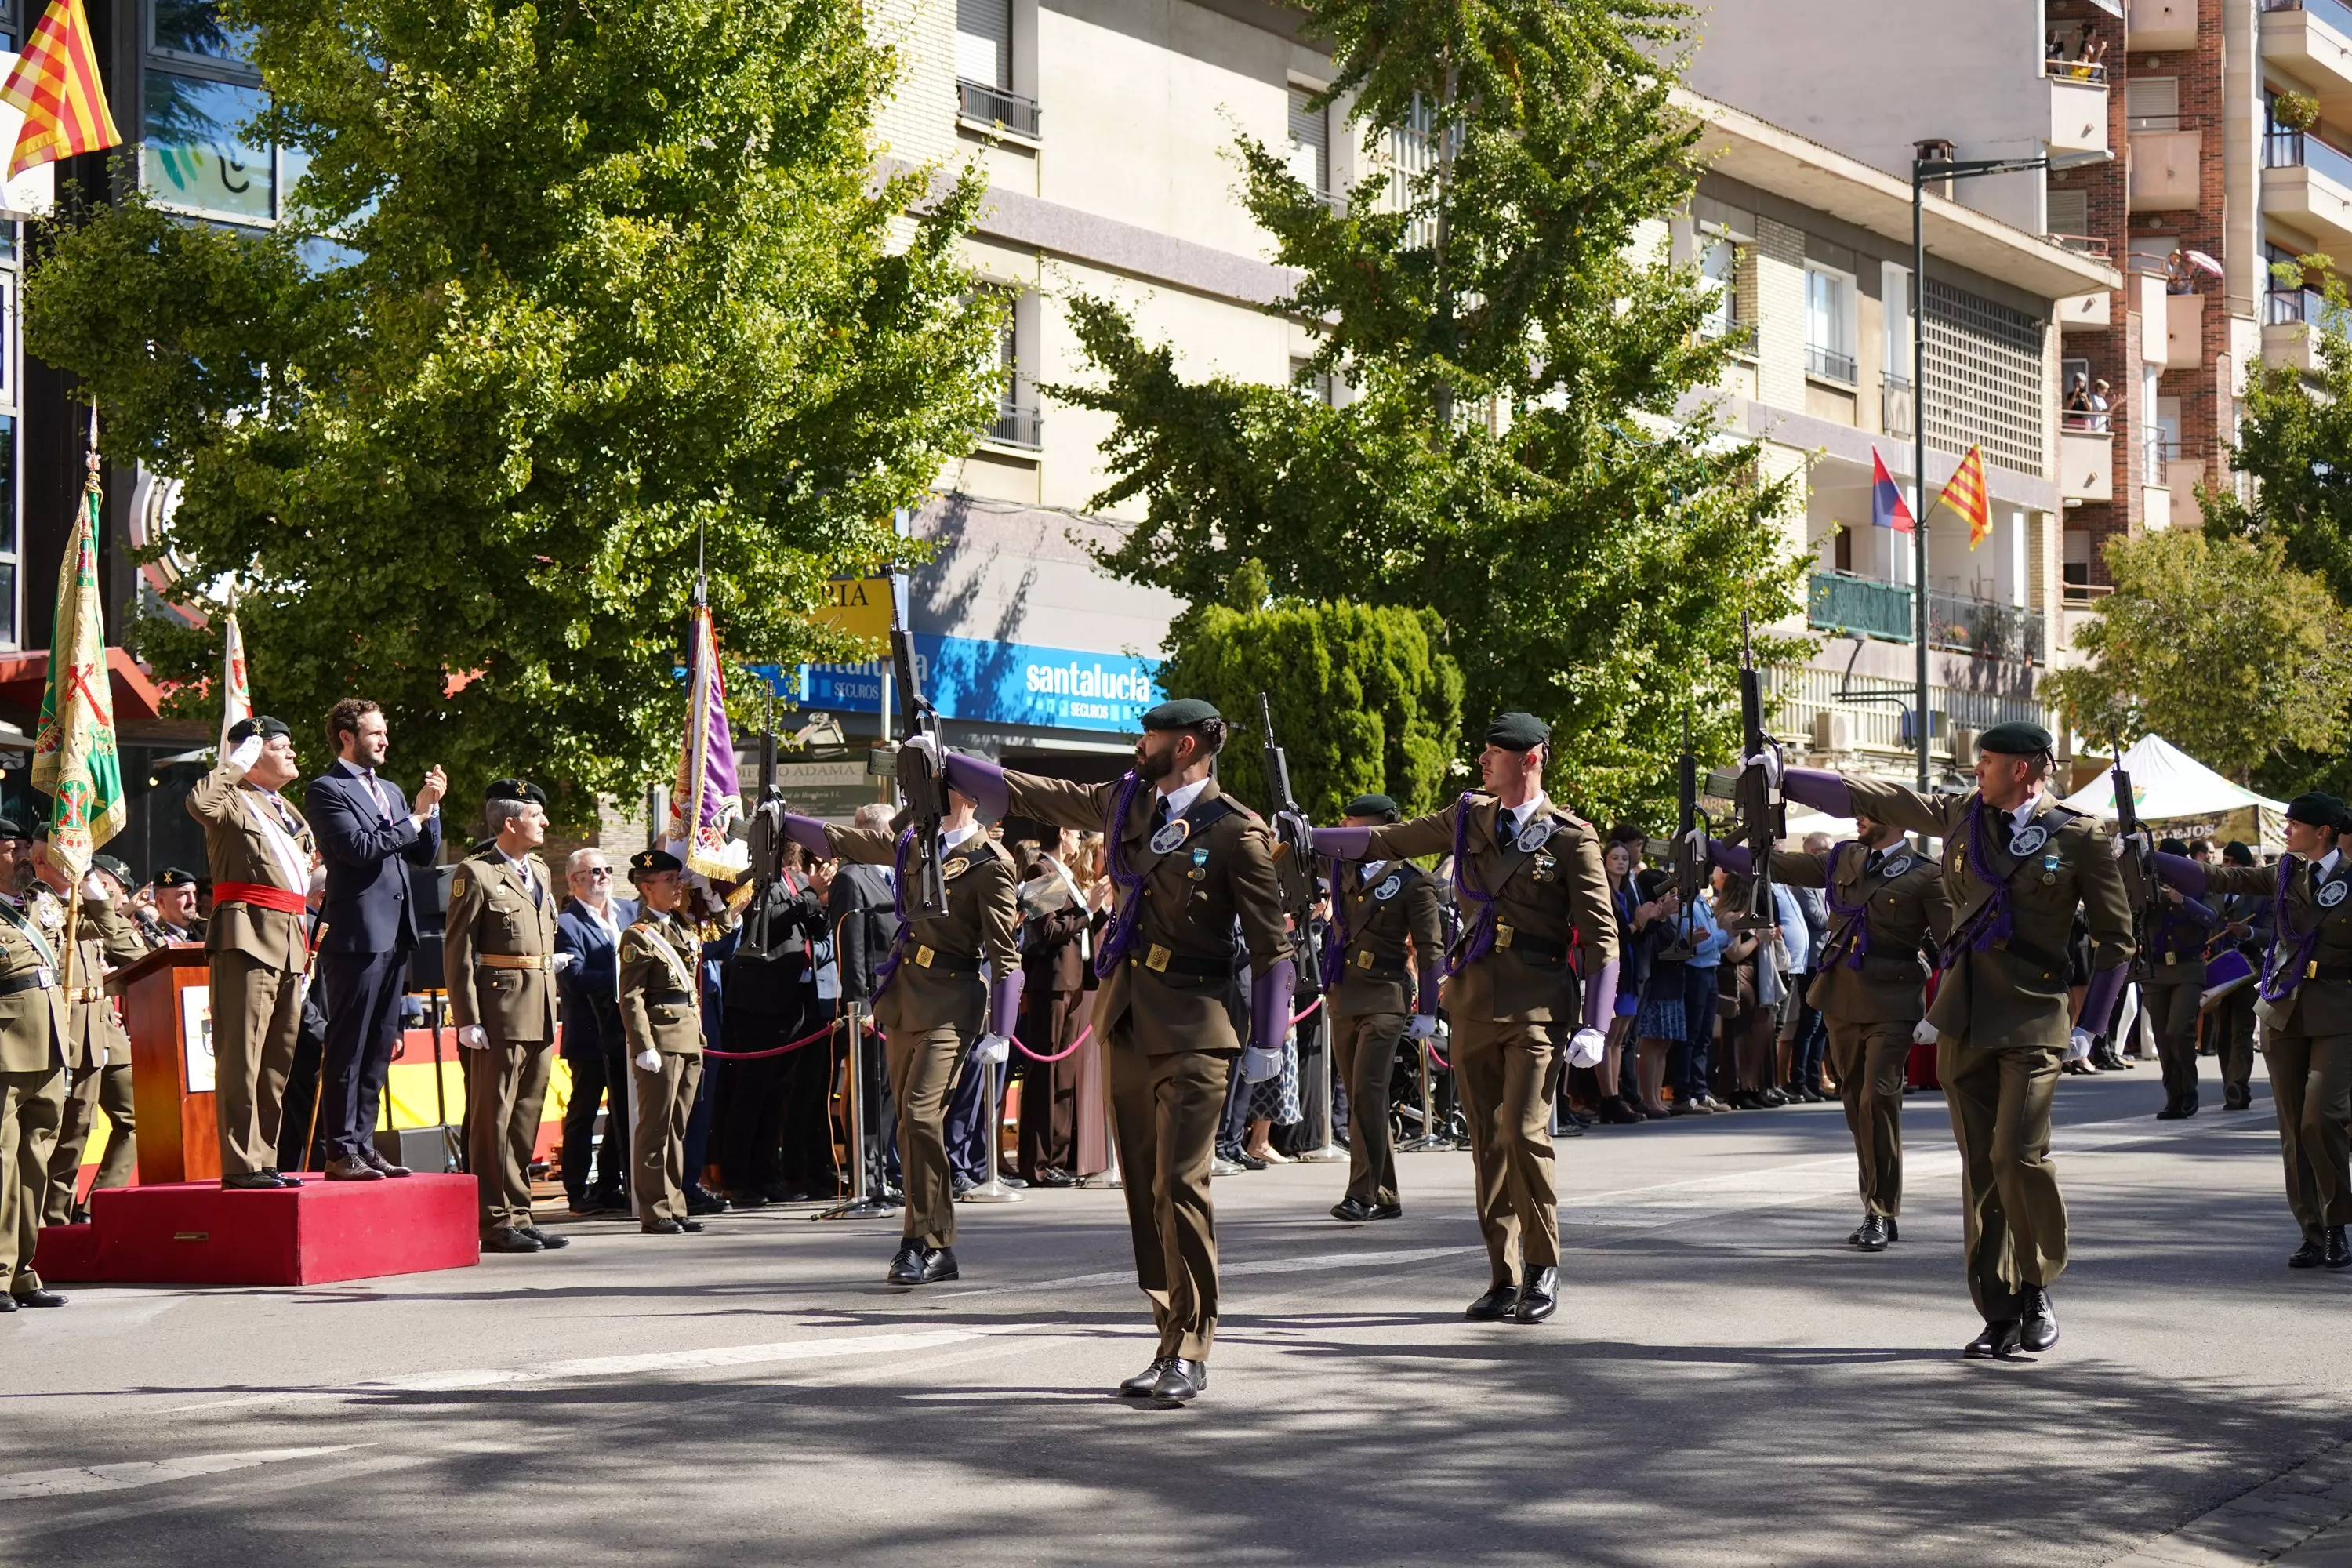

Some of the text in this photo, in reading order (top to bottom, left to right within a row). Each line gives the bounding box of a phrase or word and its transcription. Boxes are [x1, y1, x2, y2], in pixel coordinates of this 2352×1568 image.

[833, 681, 879, 699] SEGUROS
[1026, 661, 1150, 702] santalucía
[1070, 702, 1109, 720] SEGUROS
[793, 764, 855, 776] ADAMA
